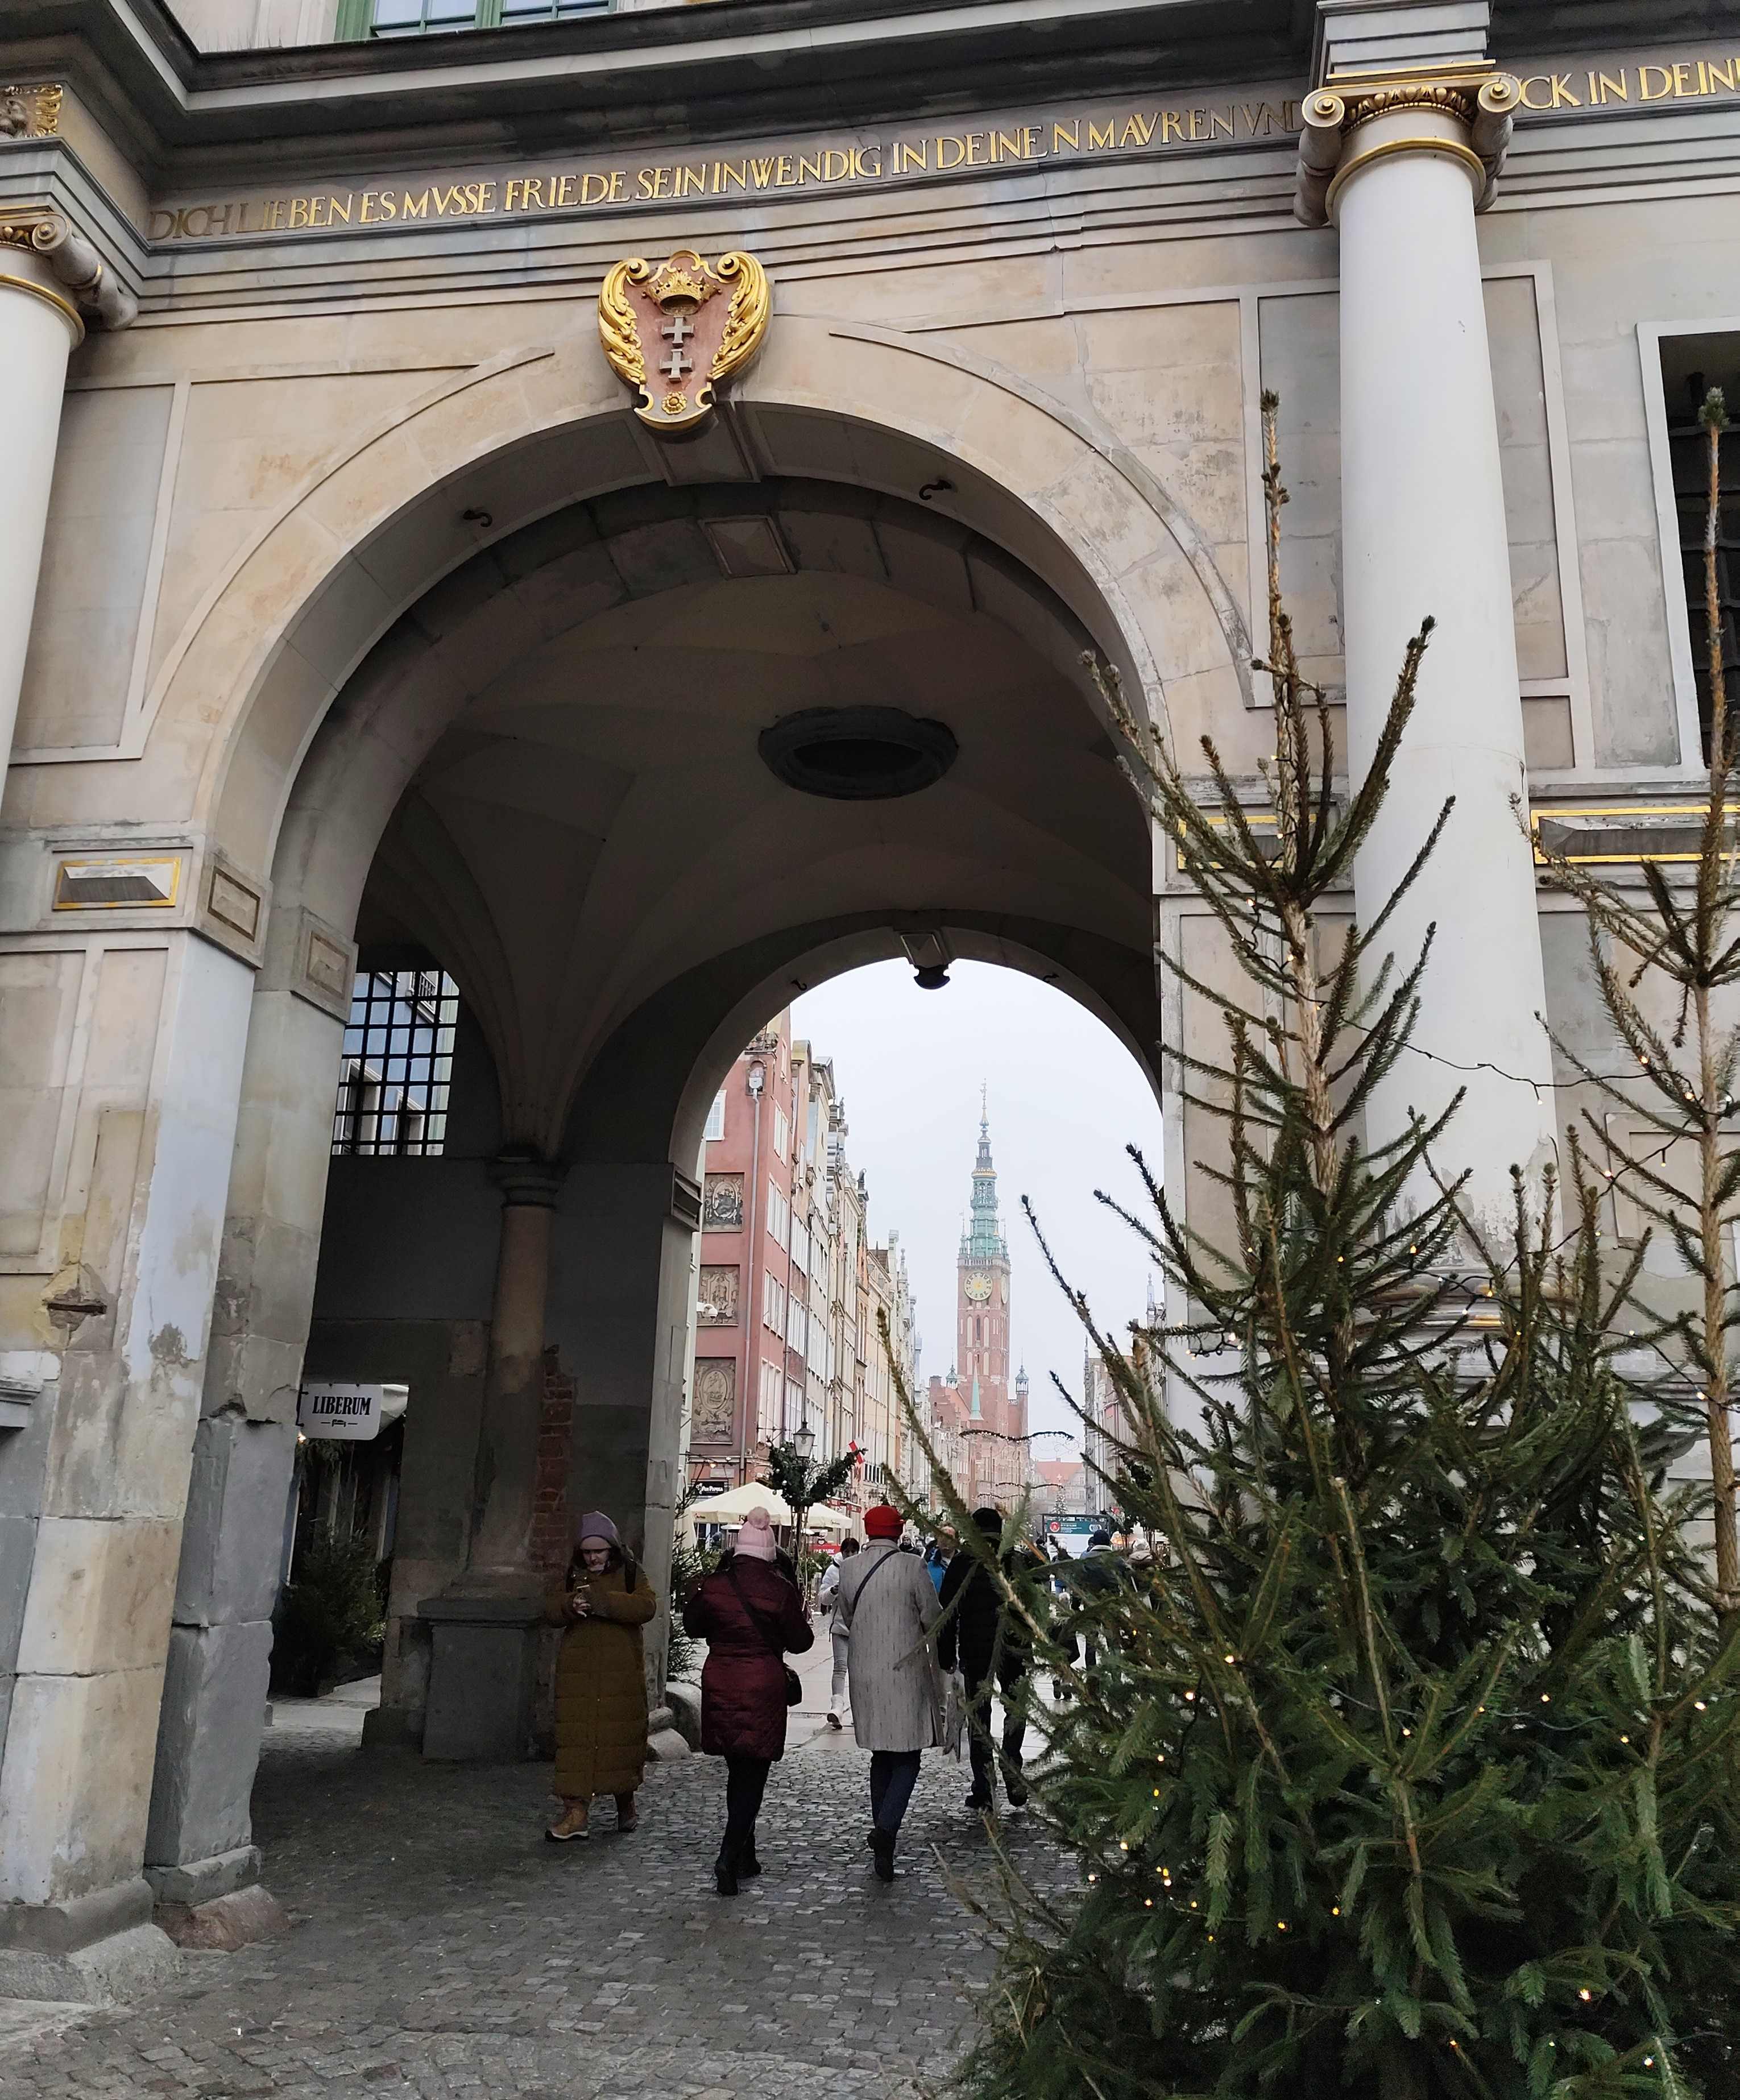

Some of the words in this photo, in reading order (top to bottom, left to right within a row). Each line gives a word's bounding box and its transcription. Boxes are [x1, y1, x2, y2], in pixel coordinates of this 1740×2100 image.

[146, 204, 233, 241] DICH
[235, 194, 353, 234] LIEBEN
[358, 191, 397, 224] ES
[401, 182, 497, 221] MVSSE
[504, 171, 632, 212] FRIEDE
[635, 163, 707, 201] SEIN
[711, 146, 882, 194] INWENDIG
[892, 139, 928, 175] IN
[1087, 105, 1234, 151] MAVREN
[1519, 73, 1582, 110] CK
[1585, 68, 1628, 106] IN
[1637, 57, 1740, 101] DEIN
[312, 1395, 372, 1415] LIBERUM
